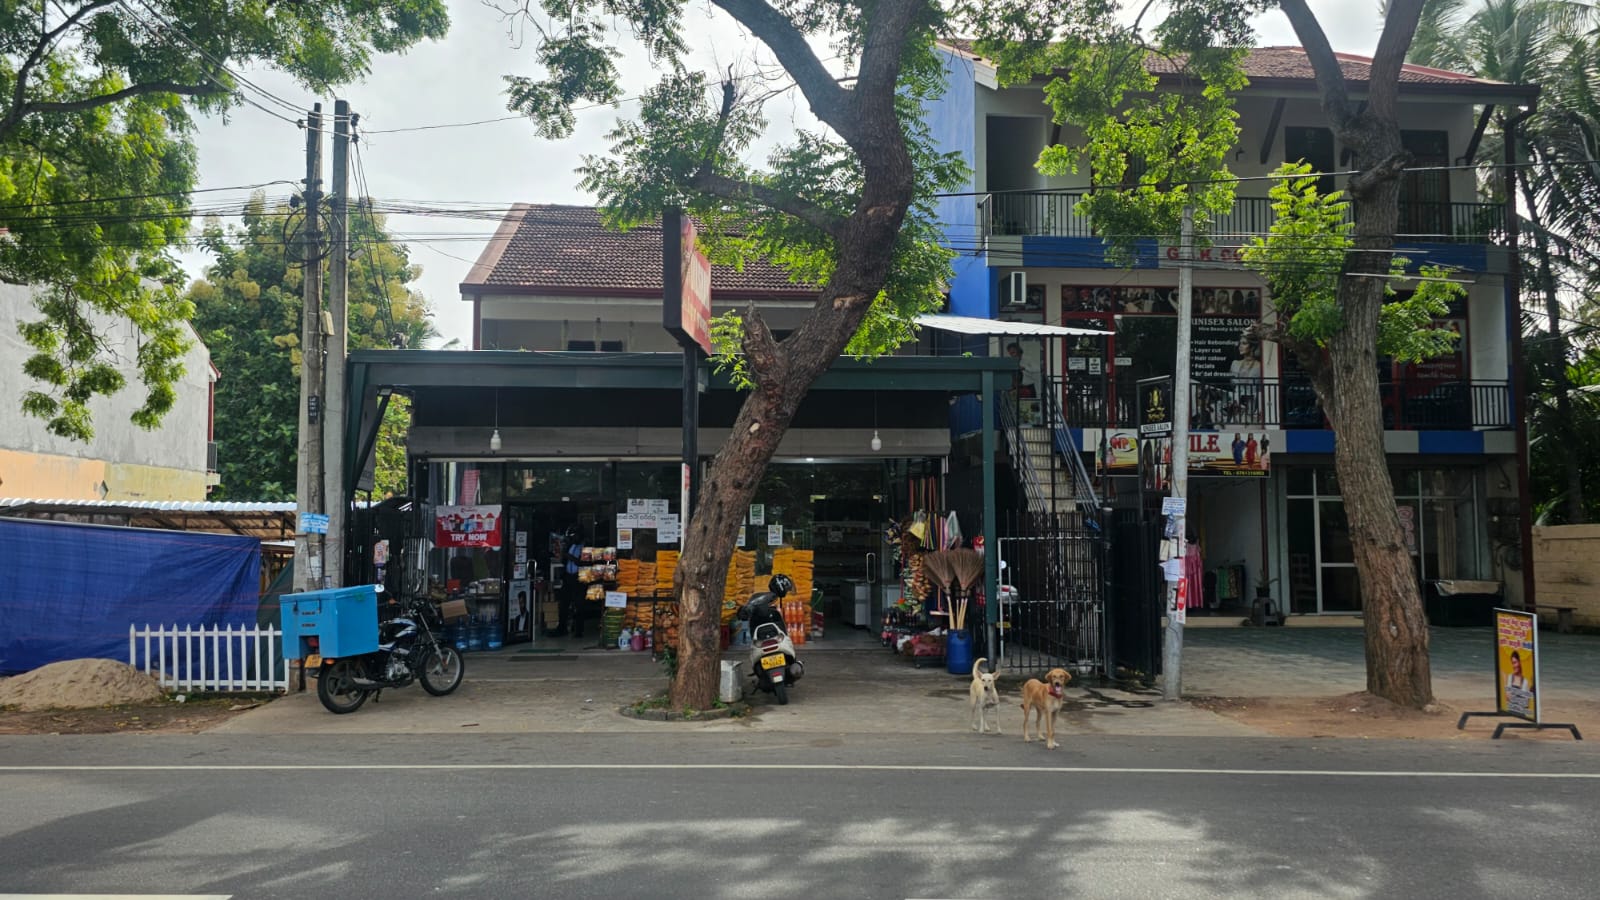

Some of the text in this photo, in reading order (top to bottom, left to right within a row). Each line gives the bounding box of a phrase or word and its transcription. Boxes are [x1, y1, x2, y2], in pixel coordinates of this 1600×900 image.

[1191, 318, 1257, 326] UNISEX SALON
[450, 533, 488, 542] TRY NOW
